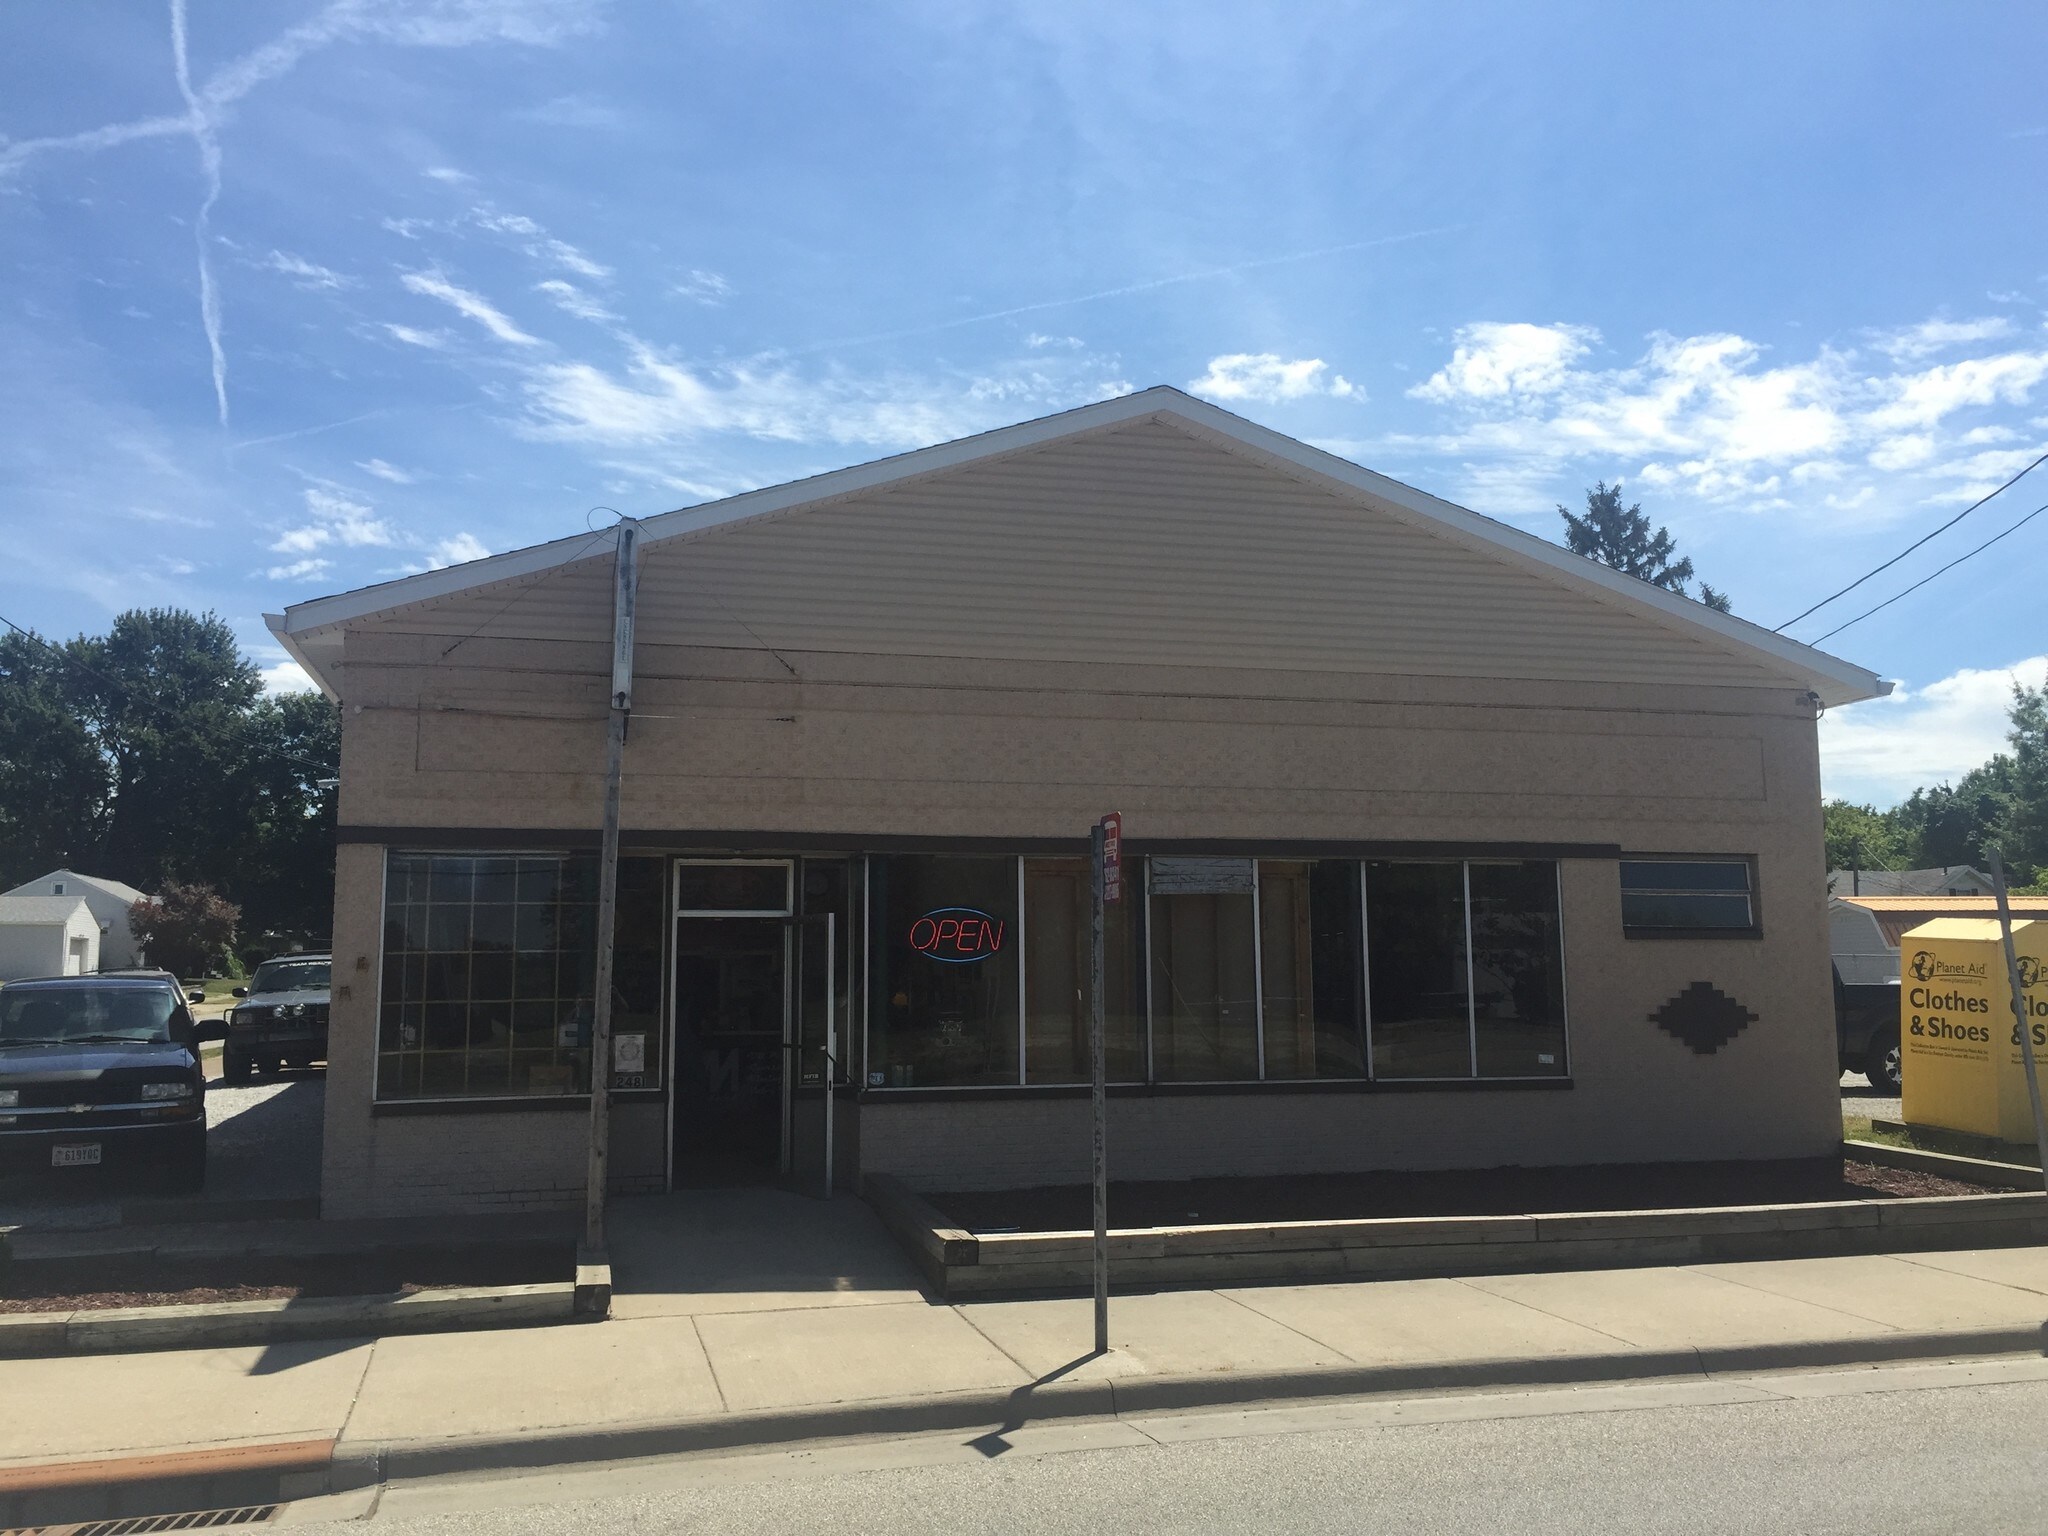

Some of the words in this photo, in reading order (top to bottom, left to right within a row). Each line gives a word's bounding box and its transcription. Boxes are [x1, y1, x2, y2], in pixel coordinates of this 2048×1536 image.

[909, 918, 1004, 951] OPEN
[1937, 961, 1965, 973] Planet
[1968, 963, 1985, 974] Aid
[1910, 988, 1989, 1013] Clothes
[1910, 1015, 1925, 1036] &
[1928, 1016, 1989, 1042] Shoes
